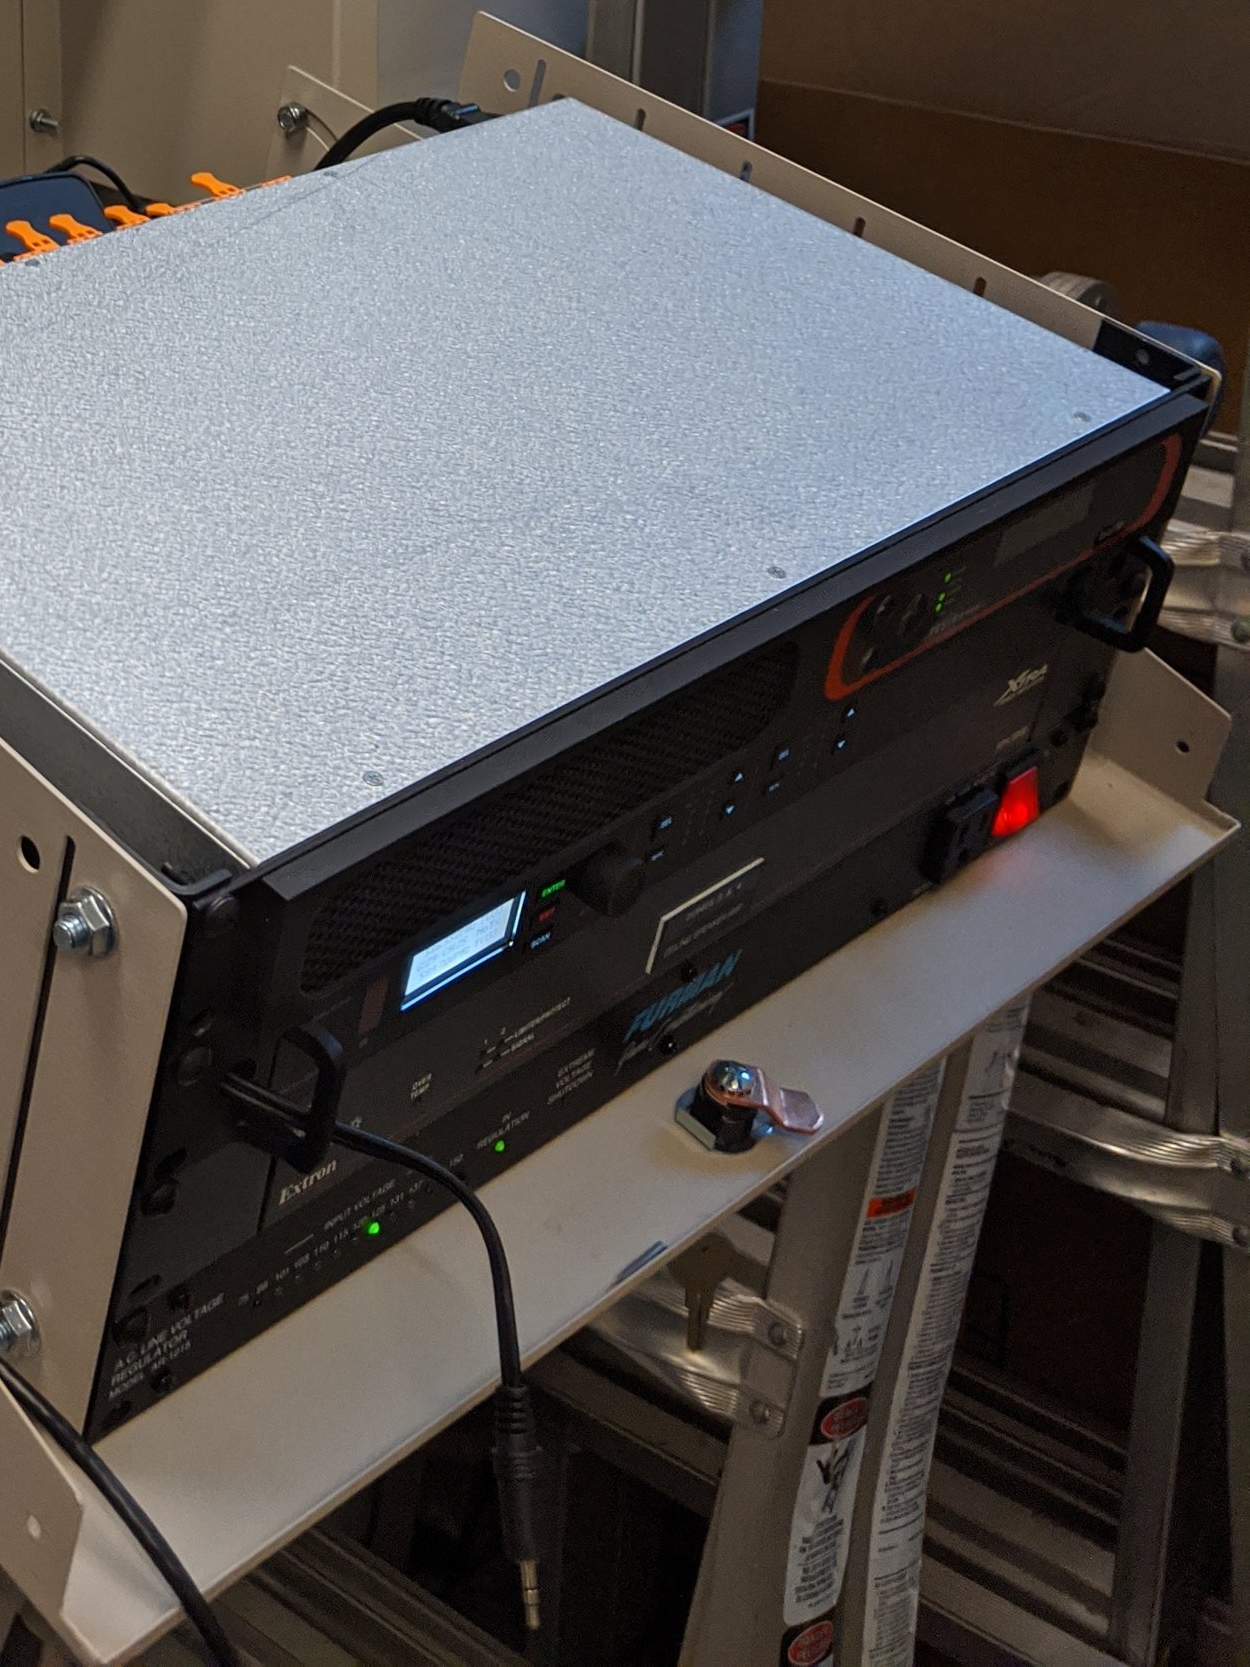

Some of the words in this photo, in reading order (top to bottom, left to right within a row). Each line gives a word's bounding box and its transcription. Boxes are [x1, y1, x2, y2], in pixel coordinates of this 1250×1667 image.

[541, 879, 566, 898] ENTER
[410, 1082, 431, 1101] TEMP
[411, 1072, 433, 1092] OVER
[547, 1069, 595, 1106] SHUTDOWN
[477, 1110, 531, 1150] REGULATION
[279, 1159, 338, 1206] Extron
[323, 1207, 352, 1231] INPUT
[353, 1178, 397, 1212] VOLTAGE
[171, 1291, 225, 1334] VOLTAGE
[110, 1329, 189, 1387] REGULATOR
[108, 1370, 145, 1400] MODEL
